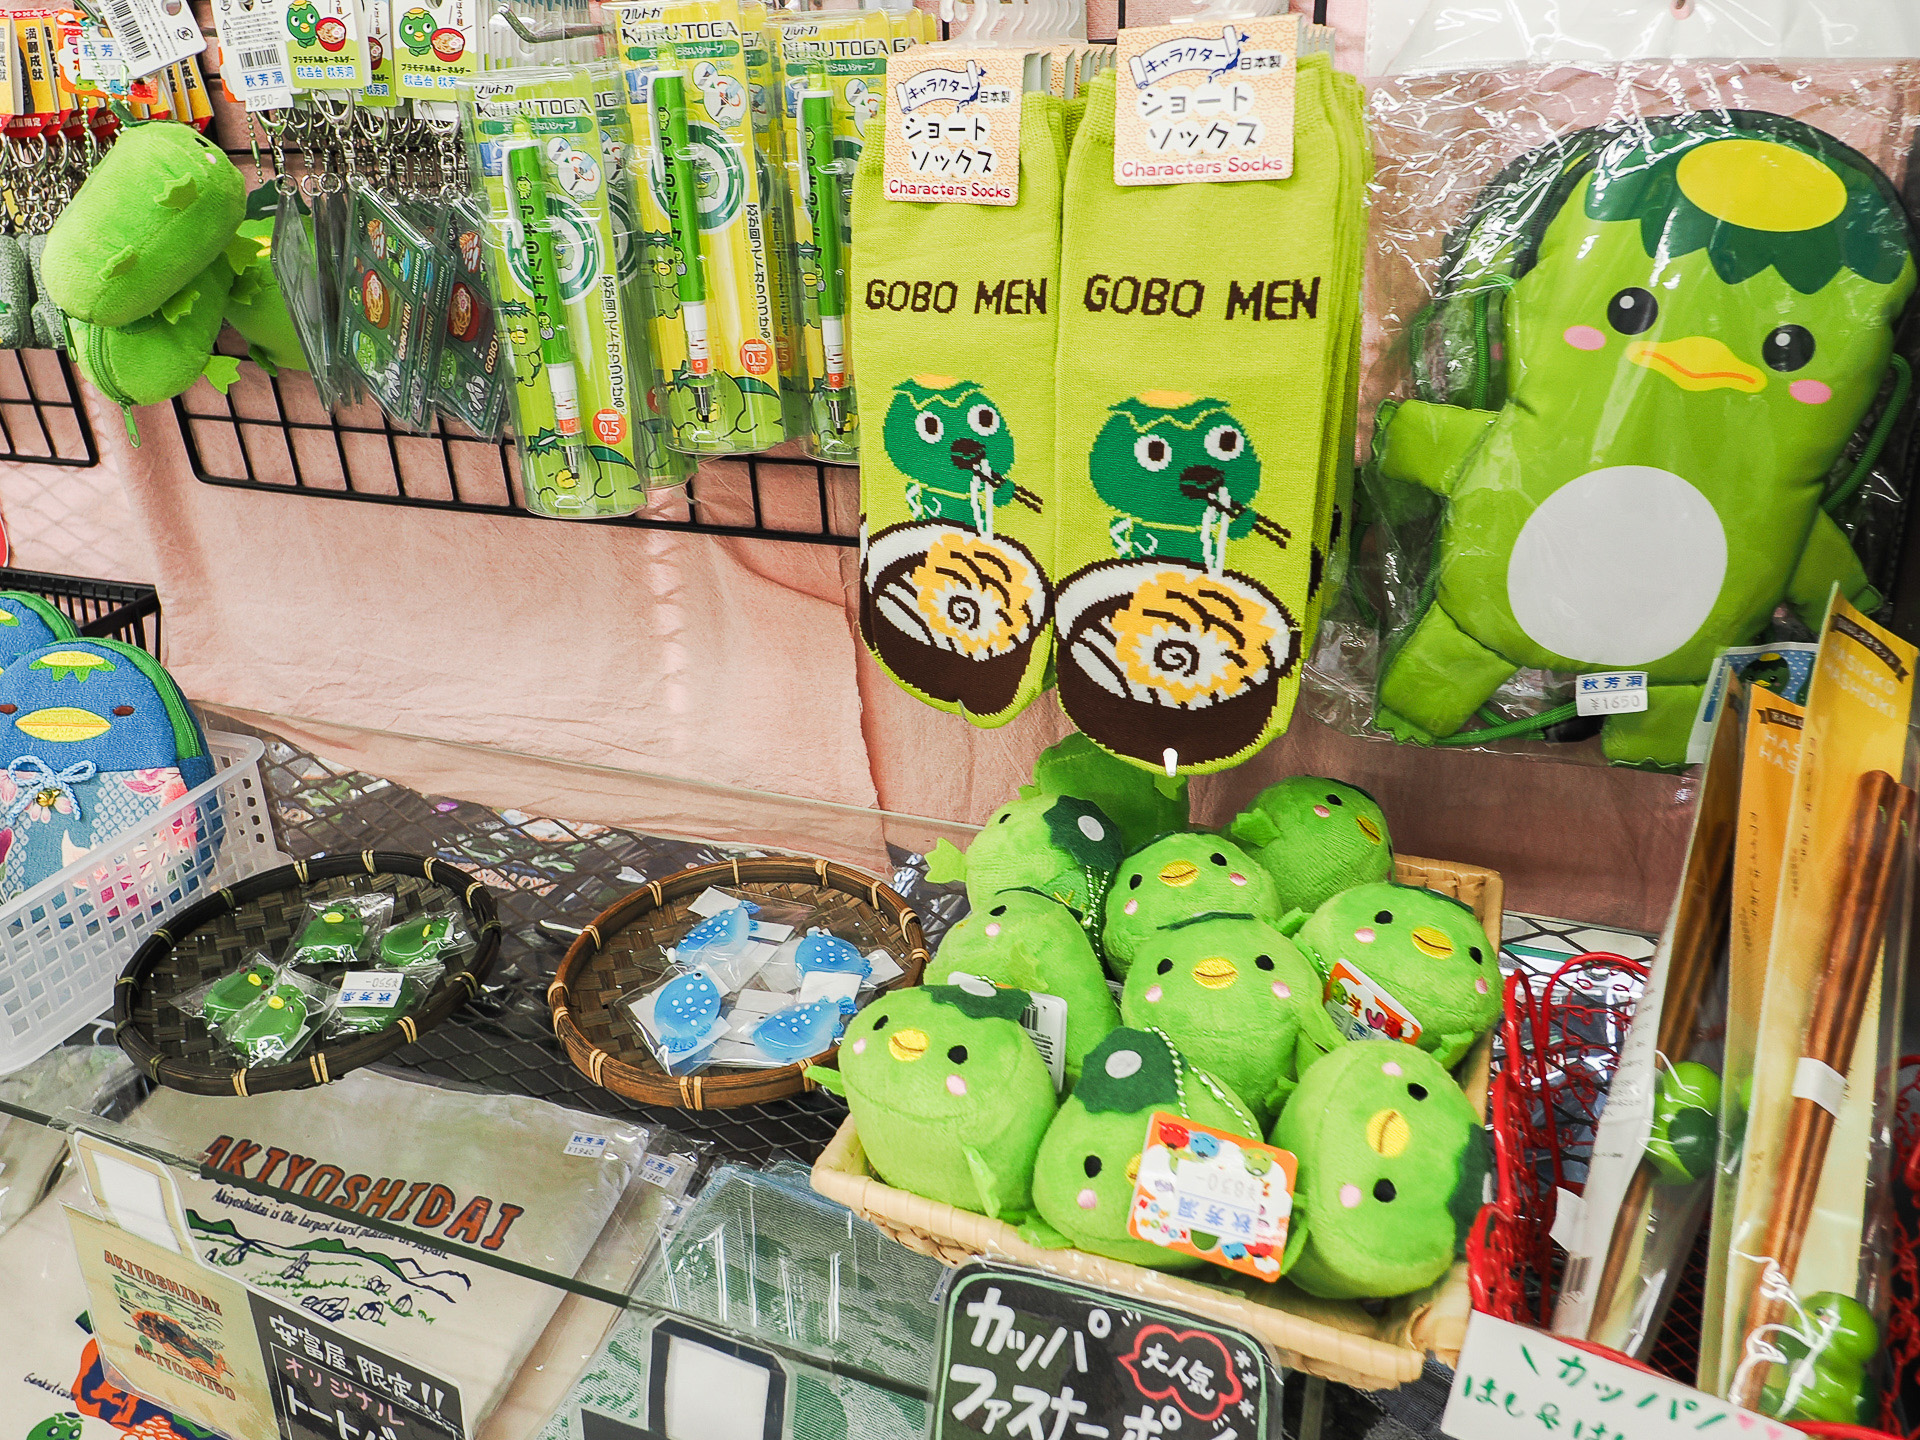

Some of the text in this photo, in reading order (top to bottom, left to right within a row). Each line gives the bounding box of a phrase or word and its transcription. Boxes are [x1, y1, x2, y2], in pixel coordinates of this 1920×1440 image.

[25, 27, 45, 81] 満願成就
[1145, 47, 1282, 73] キャラクター 日本製
[244, 70, 285, 88] 秋芳洞
[297, 67, 324, 79] 秋吉台
[327, 66, 356, 79] 秋芳洞
[404, 74, 433, 87] 秋吉台
[908, 77, 1011, 104] キャラクター 日本製
[1142, 86, 1248, 116] ショート
[905, 117, 986, 141] ショート
[1150, 122, 1257, 150] ソックス
[911, 149, 994, 174] ソックス
[1121, 155, 1284, 178] Characters Socks
[888, 179, 1011, 198] Characters Socks
[519, 204, 549, 306] アキヨシドウ
[865, 276, 1049, 315] GOBO MEN
[1083, 273, 1321, 321] GOBO MEN
[398, 326, 408, 361] GOBO
[746, 351, 768, 366] 0.5
[599, 420, 621, 435] 0.5
[1583, 675, 1644, 690] 秋芳洞
[1591, 695, 1641, 711] ¥1650
[341, 991, 392, 1002] 秋芳洞
[202, 1134, 525, 1251] AKIYOSHIDAI
[211, 1187, 269, 1218] Akiyoshidai
[270, 1201, 280, 1219] is
[280, 1205, 298, 1225] the
[298, 1214, 333, 1237] largest
[333, 1220, 361, 1239] karst
[1177, 1196, 1252, 1234] 秋芳洞
[104, 1249, 223, 1317] AKIYOSHIDAI
[966, 1287, 1111, 1373] カッパ
[134, 1343, 237, 1401] AKIYOSHIDO
[1141, 1342, 1216, 1401] 大人気
[285, 1356, 405, 1426] オリジナル
[949, 1363, 1240, 1440] ファスナーポ
